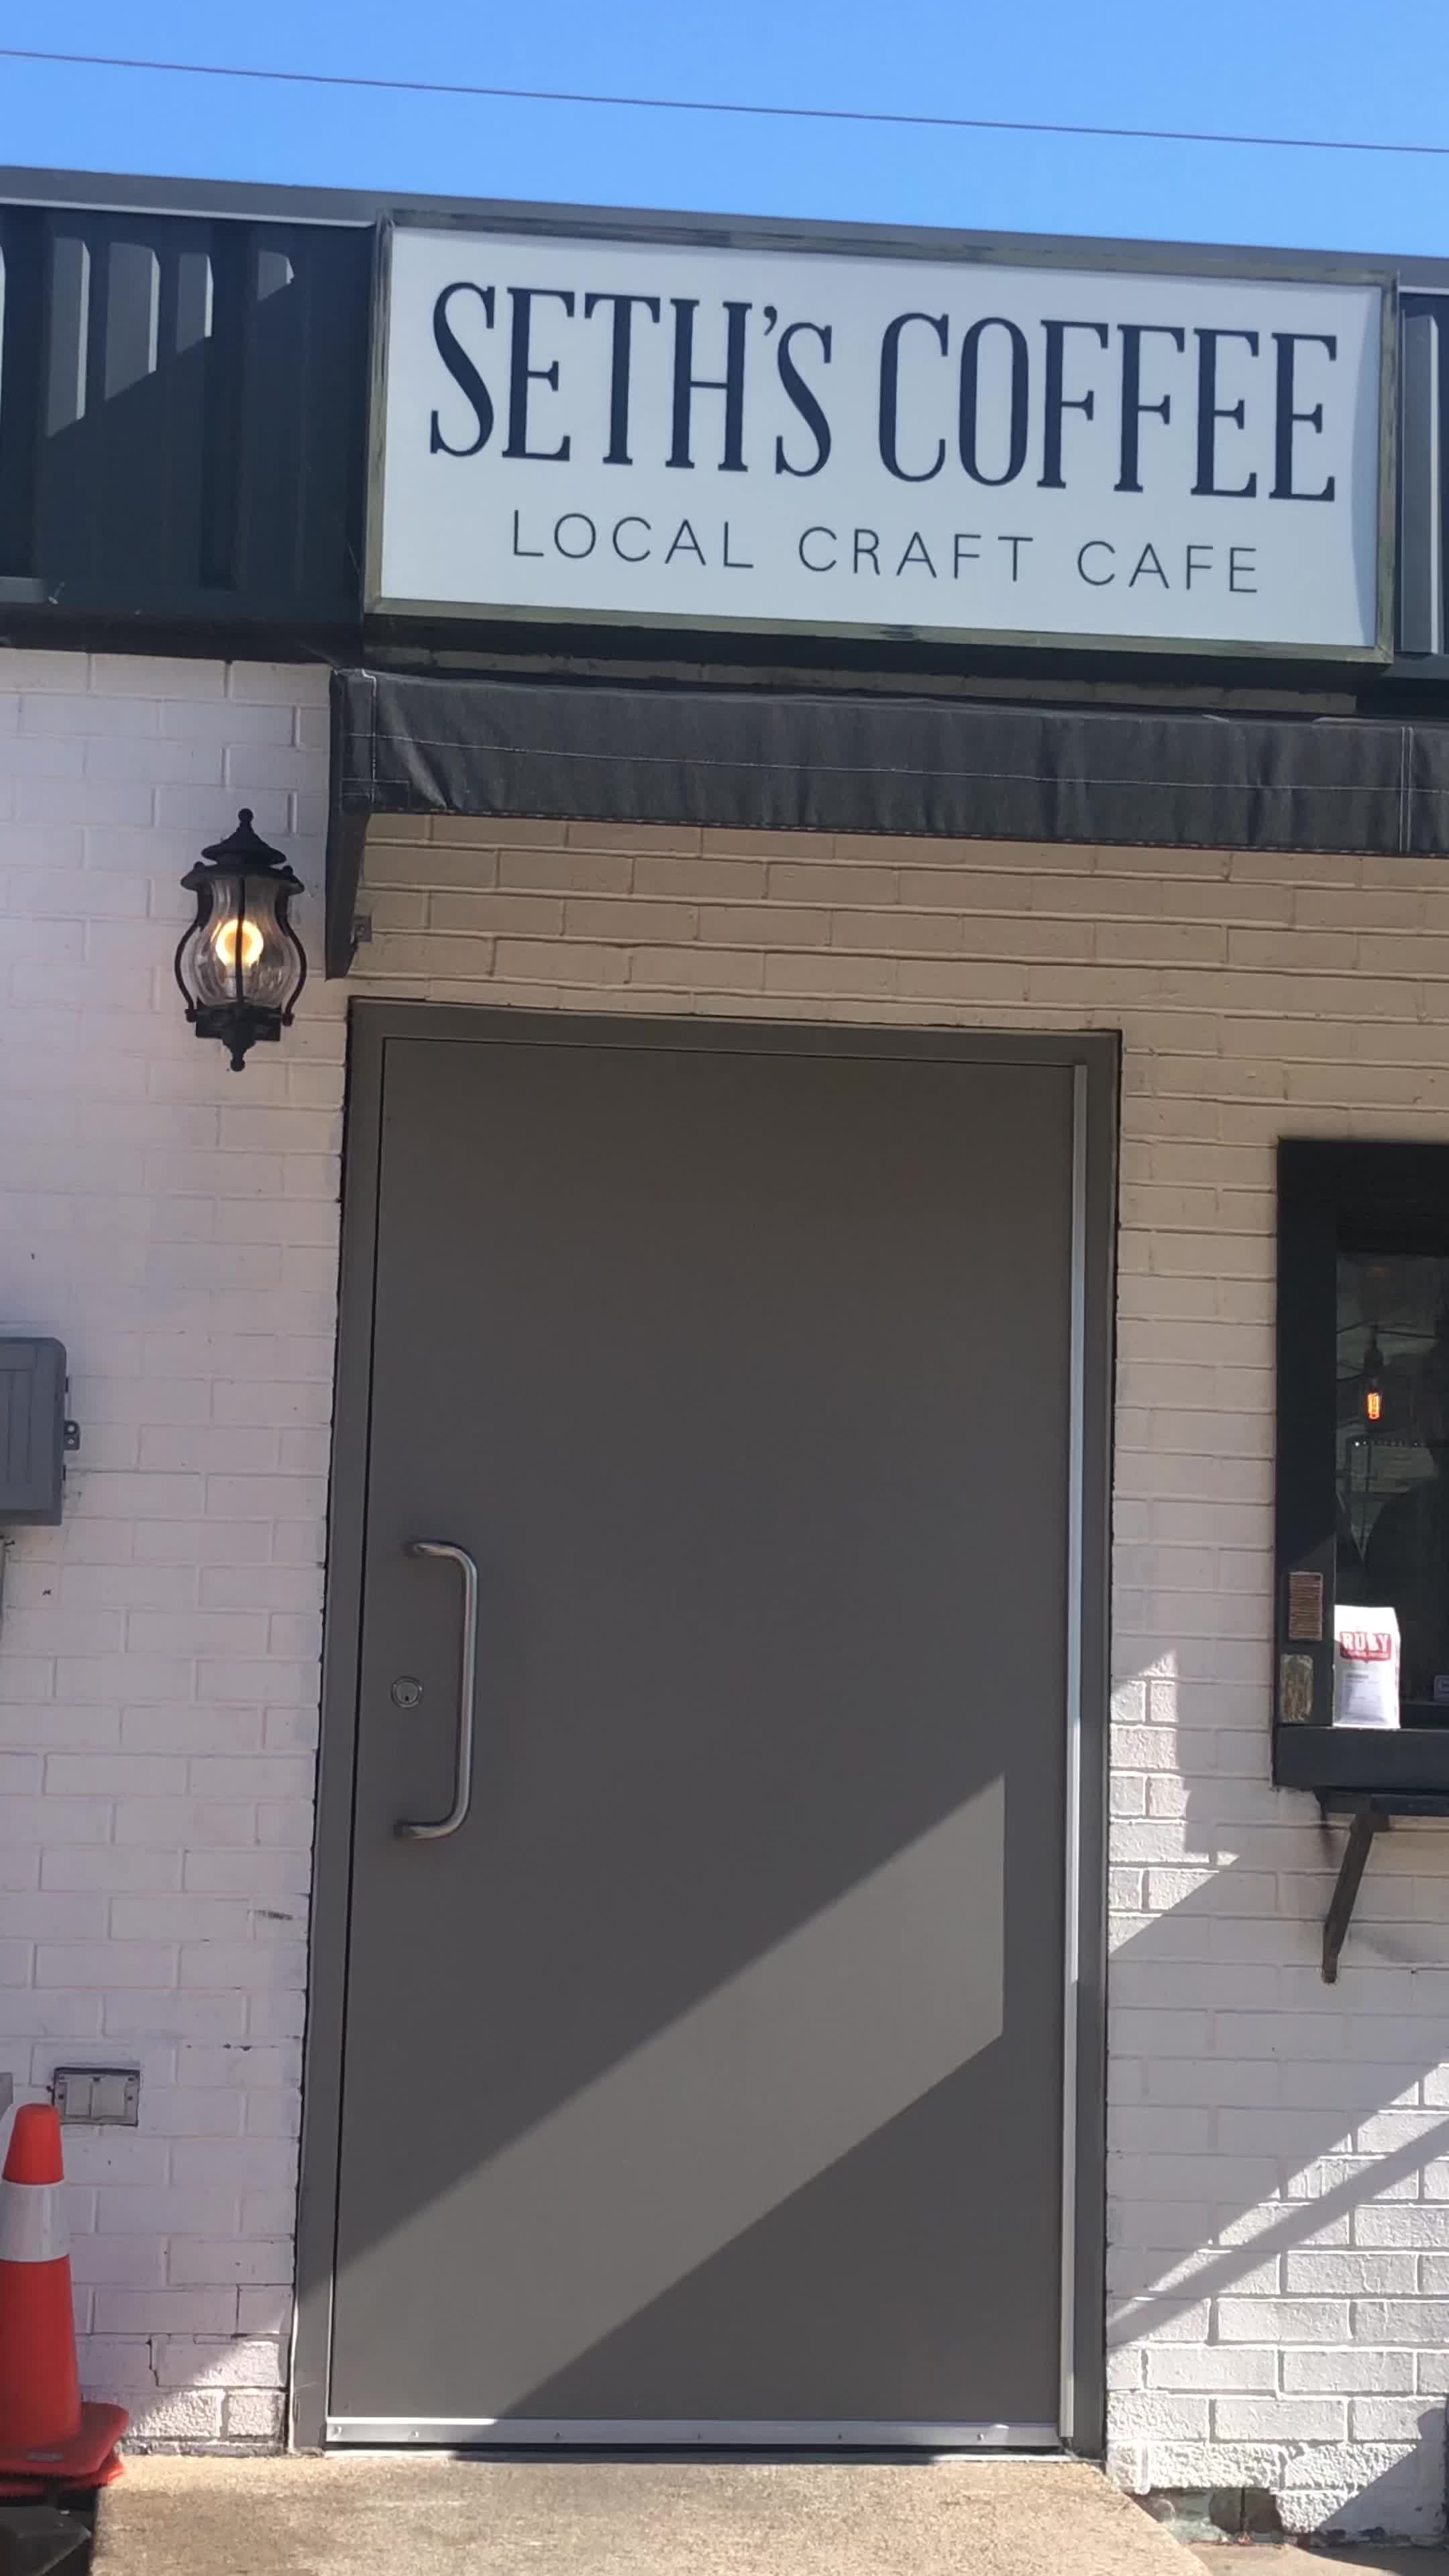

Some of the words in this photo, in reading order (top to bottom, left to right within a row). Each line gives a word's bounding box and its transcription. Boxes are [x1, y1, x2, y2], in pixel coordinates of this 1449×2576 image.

[878, 311, 1338, 503] COFFEE
[513, 509, 754, 569] LOCAL
[798, 526, 1034, 582] CRAFT
[1077, 540, 1258, 594] CAFE
